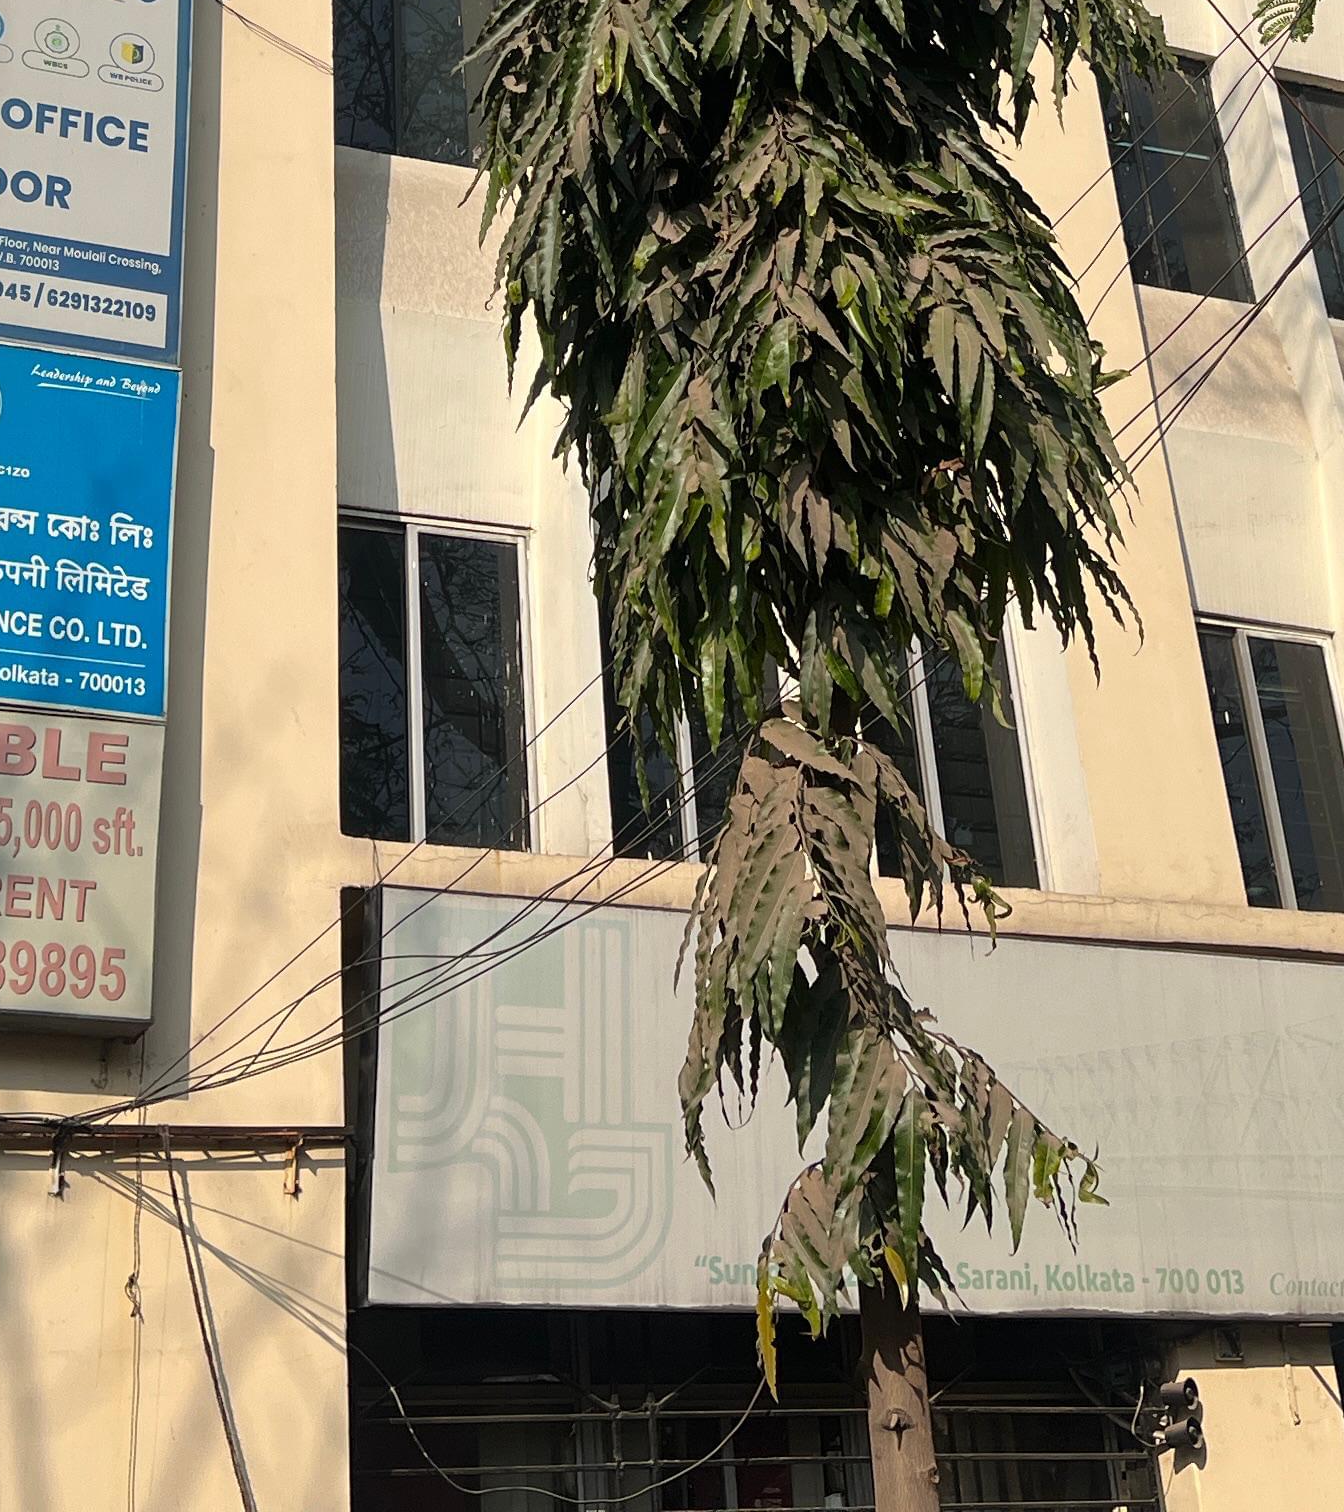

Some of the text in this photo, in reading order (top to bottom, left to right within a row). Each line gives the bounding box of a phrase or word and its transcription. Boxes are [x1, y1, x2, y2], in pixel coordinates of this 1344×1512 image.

[0, 96, 151, 153] OFFICE
[19, 254, 61, 272] 700013
[32, 241, 62, 256] Near
[108, 253, 162, 276] Crossing,
[46, 288, 157, 322] 6291322109
[31, 363, 161, 396] Leadership and Beyond
[54, 558, 151, 602] लिमिटेड
[48, 615, 90, 644] CO.
[97, 620, 148, 650] LTD.
[79, 671, 147, 697] 700013
[91, 807, 145, 858] sft.
[956, 1261, 1039, 1296] Sarani,
[1044, 1263, 1137, 1294] Kolkata
[1155, 1267, 1201, 1295] 700
[1206, 1268, 1245, 1296] 013
